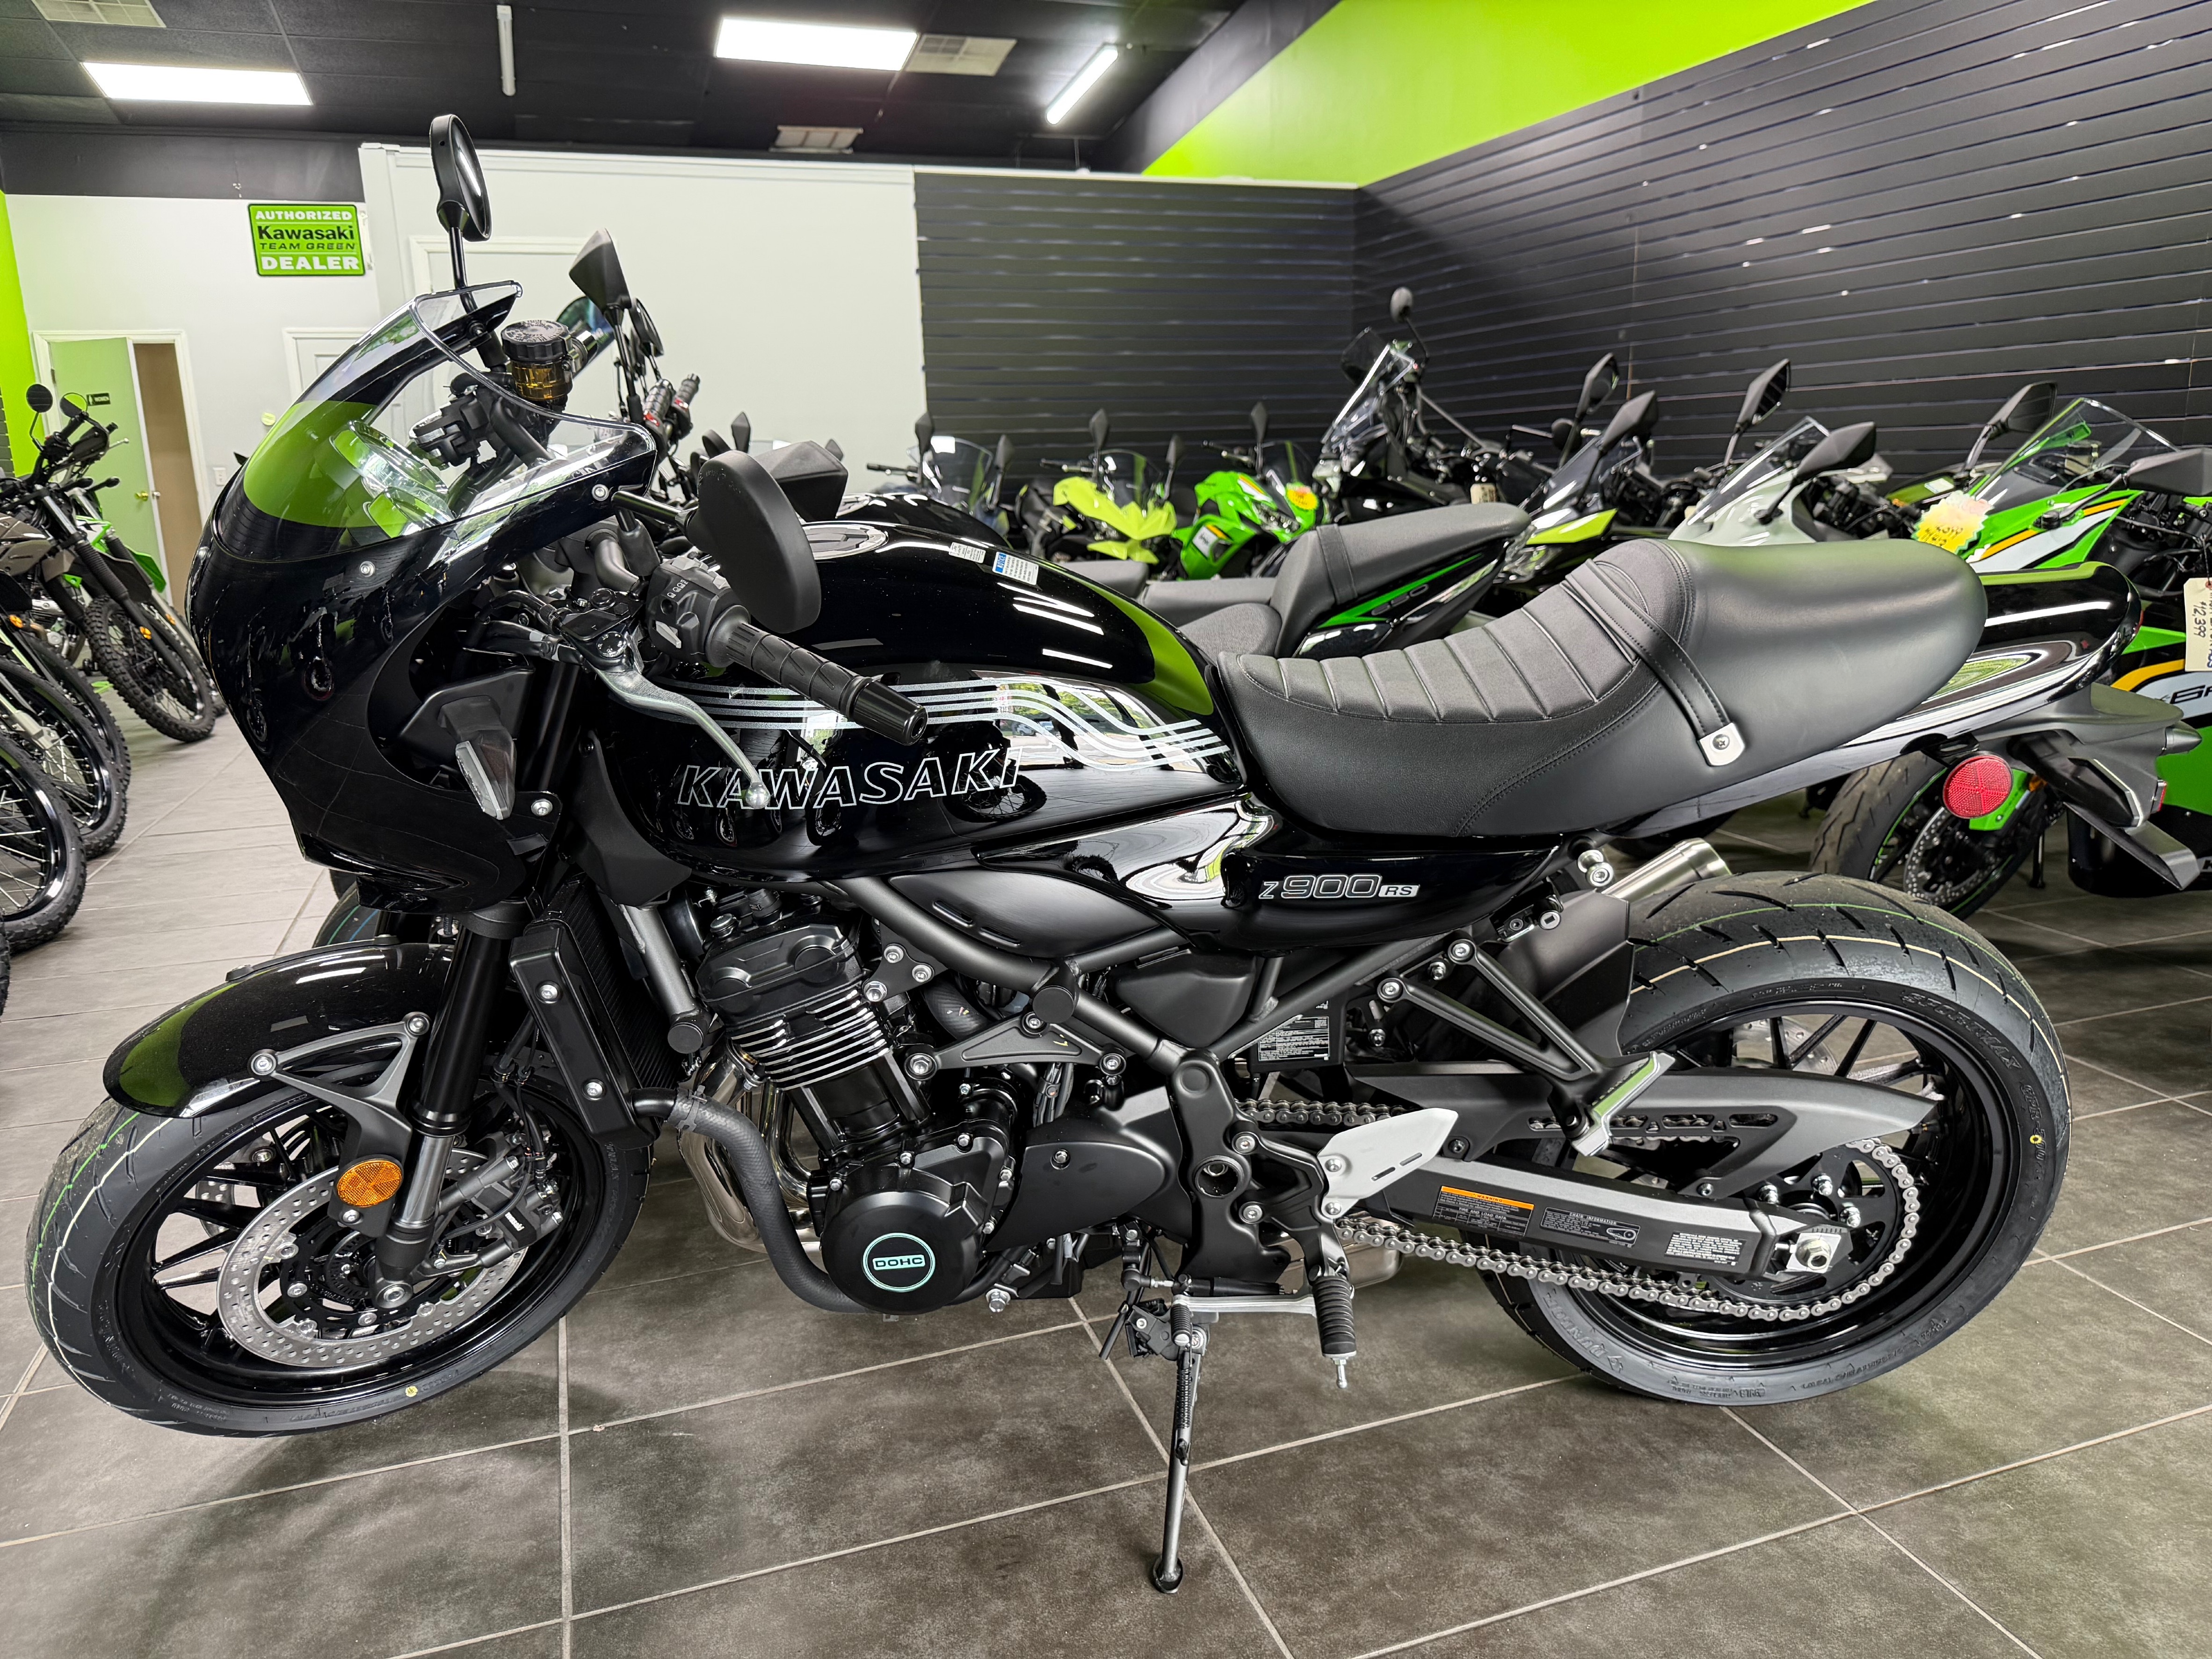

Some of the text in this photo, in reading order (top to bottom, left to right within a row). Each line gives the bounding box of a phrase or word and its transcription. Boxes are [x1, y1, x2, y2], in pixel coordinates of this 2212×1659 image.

[255, 211, 353, 220] AUTHORIZED
[257, 226, 355, 240] Kawasaki
[261, 256, 360, 270] DEALER
[2193, 602, 2206, 638] $12,399
[677, 746, 1023, 810] KAWASAKI
[1477, 1194, 1503, 1203] WARNING
[1586, 1216, 1617, 1225] INFORMATION
[875, 1257, 923, 1267] DOHC
